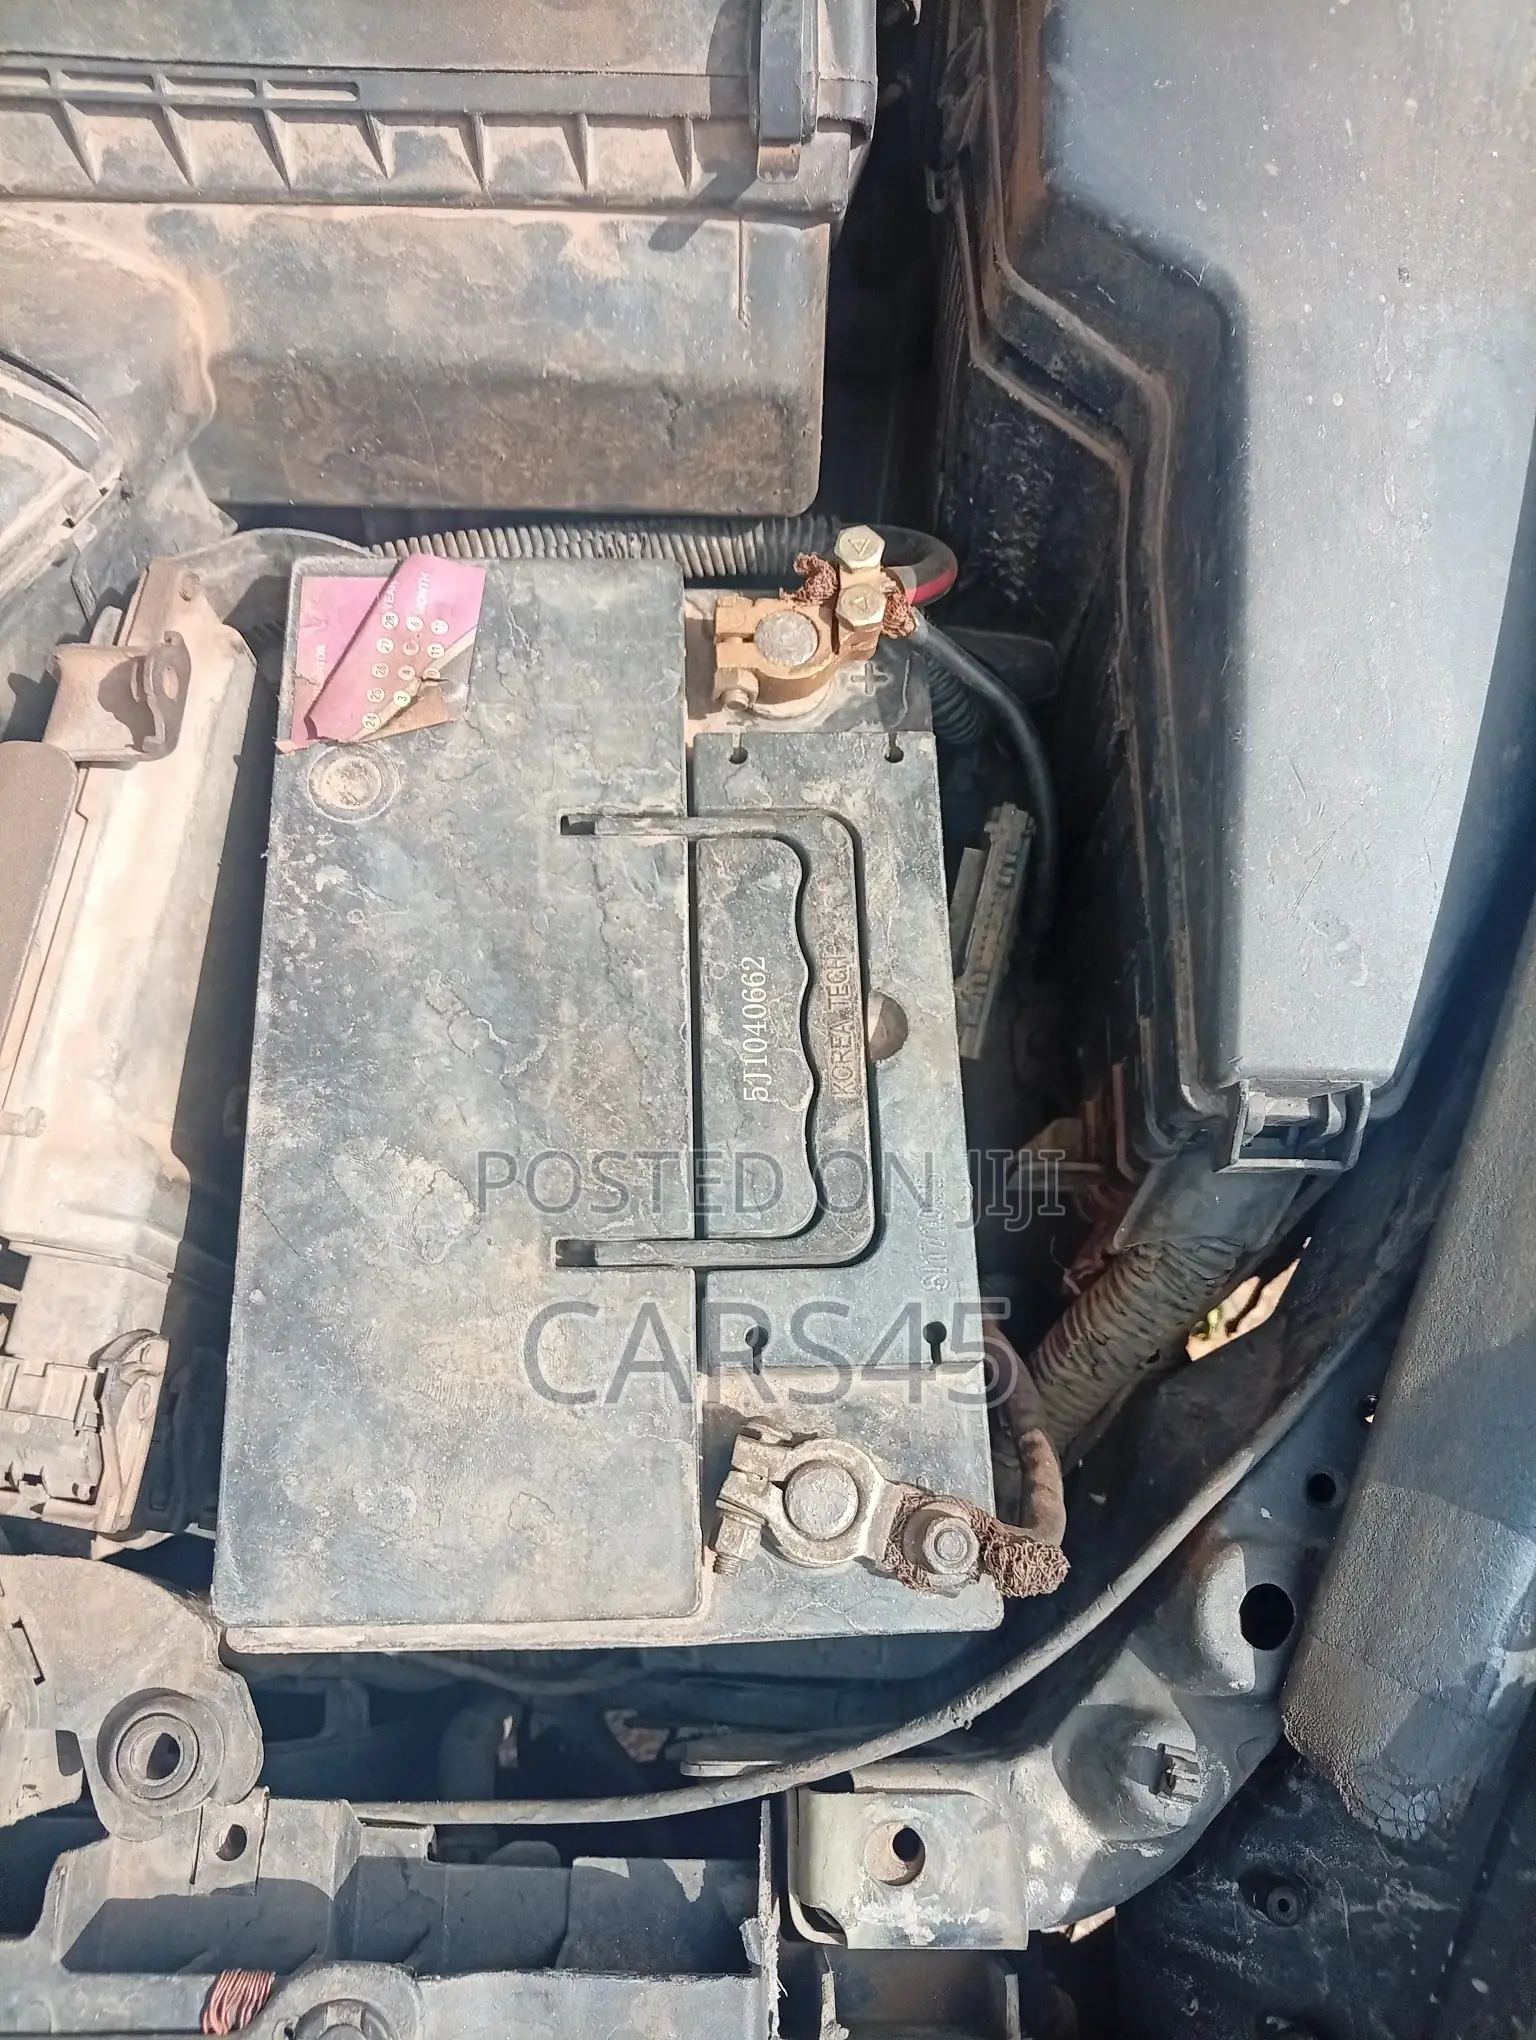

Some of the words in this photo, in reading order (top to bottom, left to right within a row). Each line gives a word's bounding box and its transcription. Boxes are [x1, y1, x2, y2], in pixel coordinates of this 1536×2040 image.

[826, 955, 850, 1011] TECH
[741, 955, 773, 1102] 5J1040662
[829, 1017, 857, 1096] KOREA
